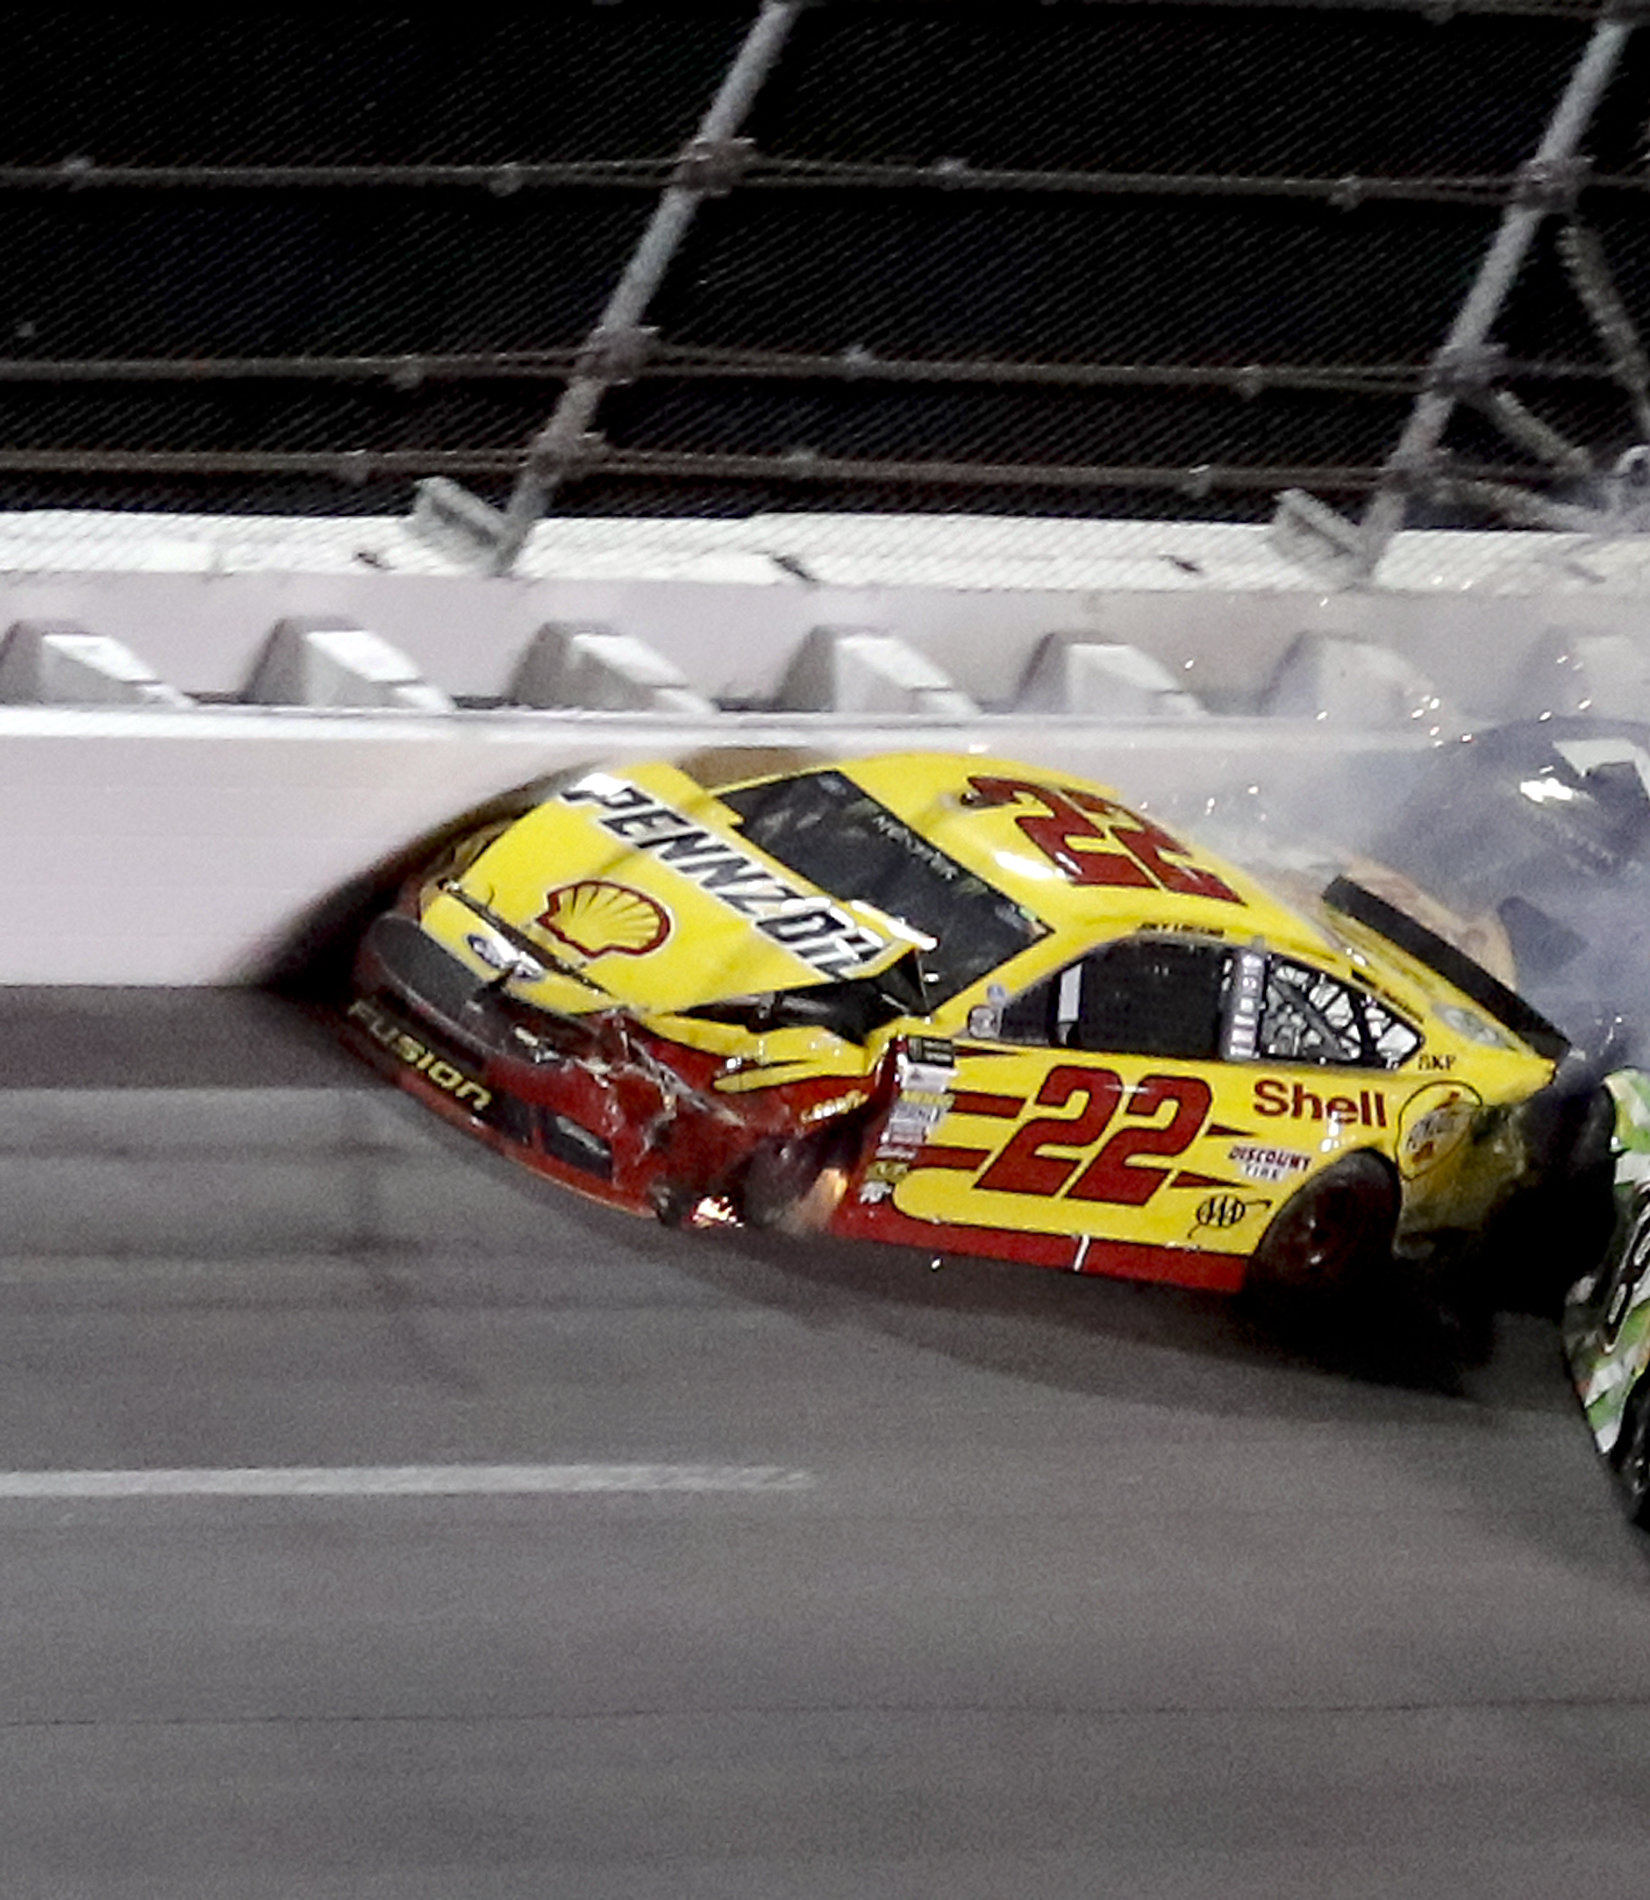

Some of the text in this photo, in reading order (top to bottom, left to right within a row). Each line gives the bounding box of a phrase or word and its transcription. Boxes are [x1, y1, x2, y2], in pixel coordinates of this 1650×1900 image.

[560, 772, 893, 982] PENNZOIL
[965, 775, 1248, 908] 22
[348, 998, 493, 1112] FUSION
[1254, 1079, 1388, 1128] Shell
[972, 1065, 1213, 1207] 22
[1228, 1146, 1312, 1172] DISCOUNT
